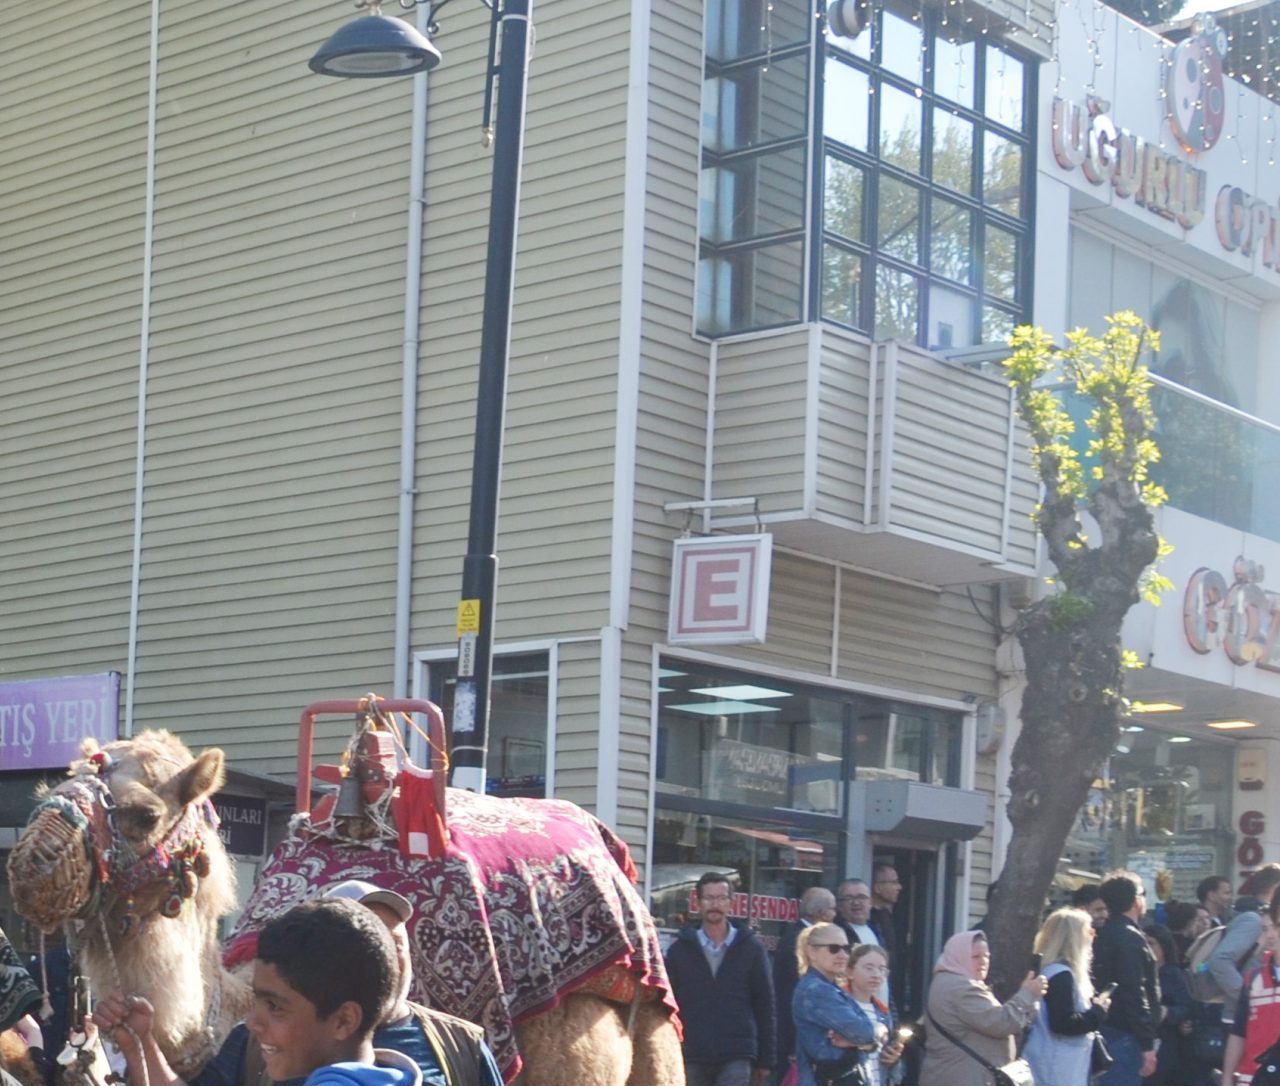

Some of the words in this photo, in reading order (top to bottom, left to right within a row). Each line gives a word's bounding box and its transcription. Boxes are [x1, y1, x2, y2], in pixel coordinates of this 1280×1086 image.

[1050, 93, 1208, 231] UĞURLU
[693, 559, 740, 622] E
[44, 686, 112, 745] YERİ
